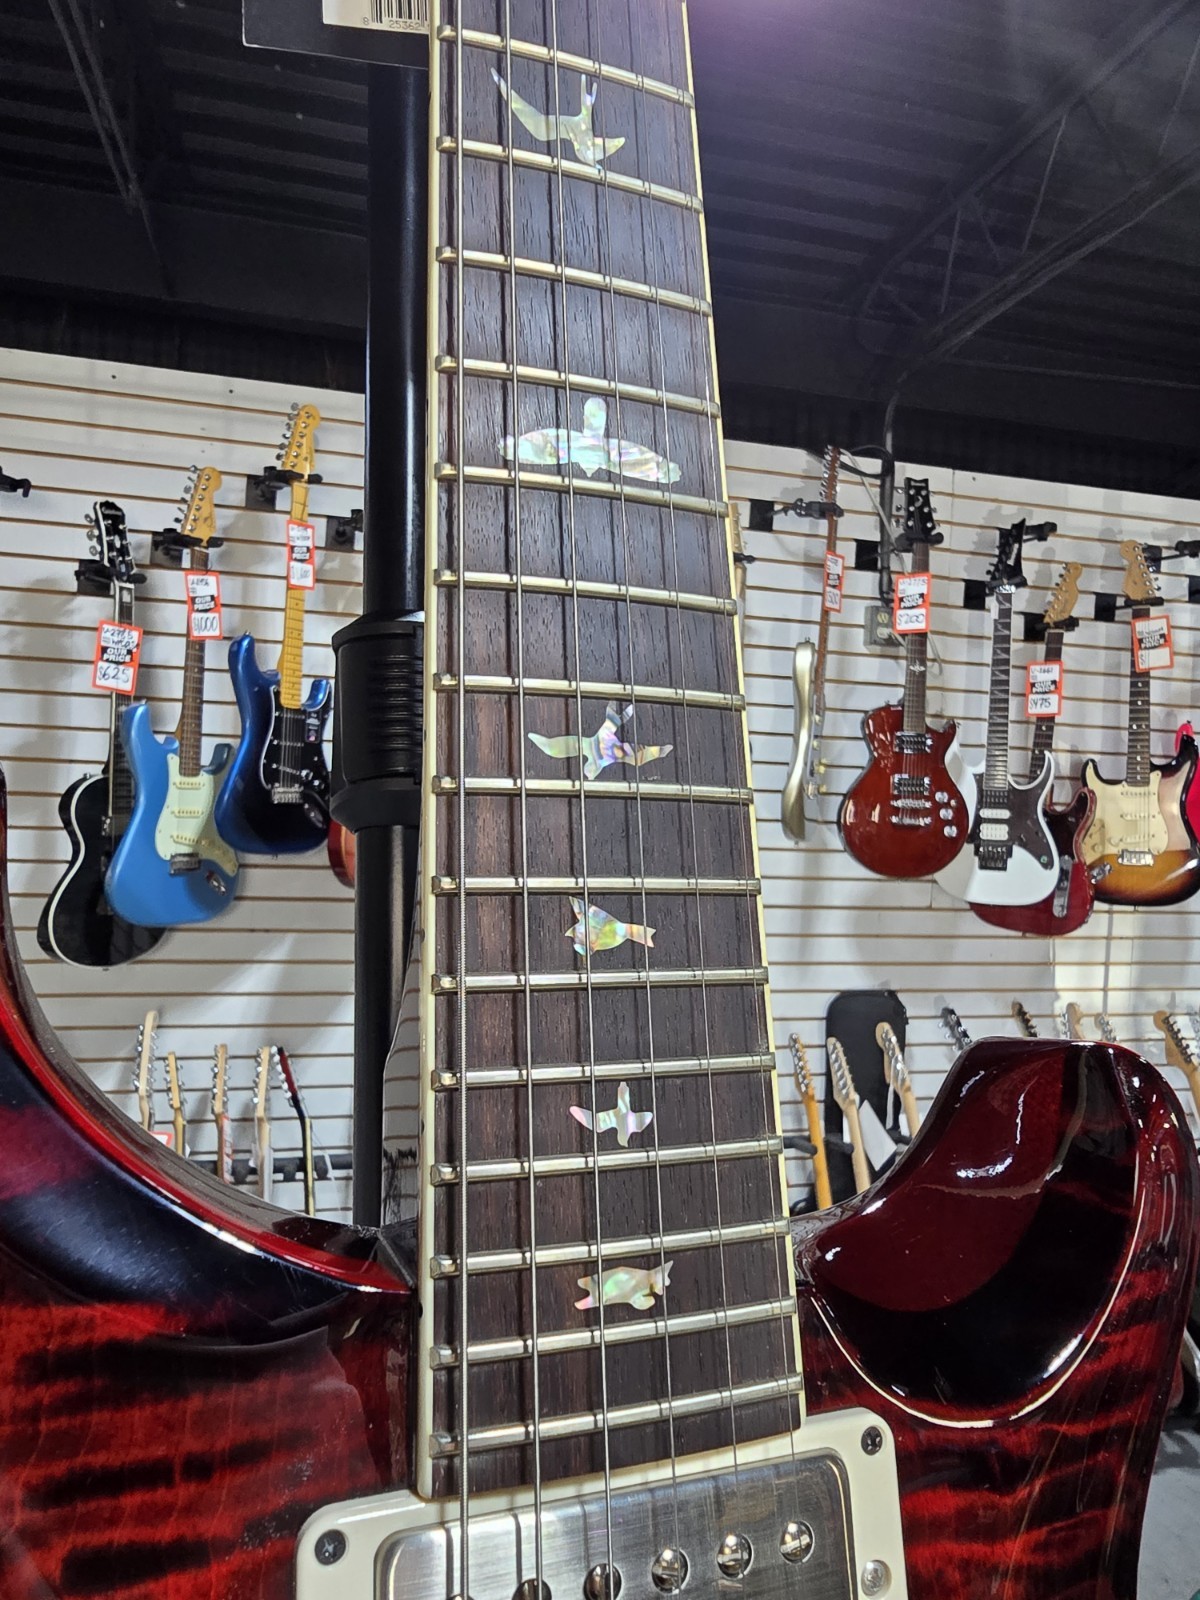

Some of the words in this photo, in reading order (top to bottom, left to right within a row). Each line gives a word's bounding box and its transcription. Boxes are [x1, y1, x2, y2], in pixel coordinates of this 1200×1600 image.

[362, 16, 370, 26] 8
[388, 19, 422, 31] 25362
[195, 596, 212, 604] OUR
[193, 601, 215, 610] PRICE
[106, 647, 128, 656] OUR
[102, 653, 132, 662] PRICE
[97, 665, 130, 683] $625
